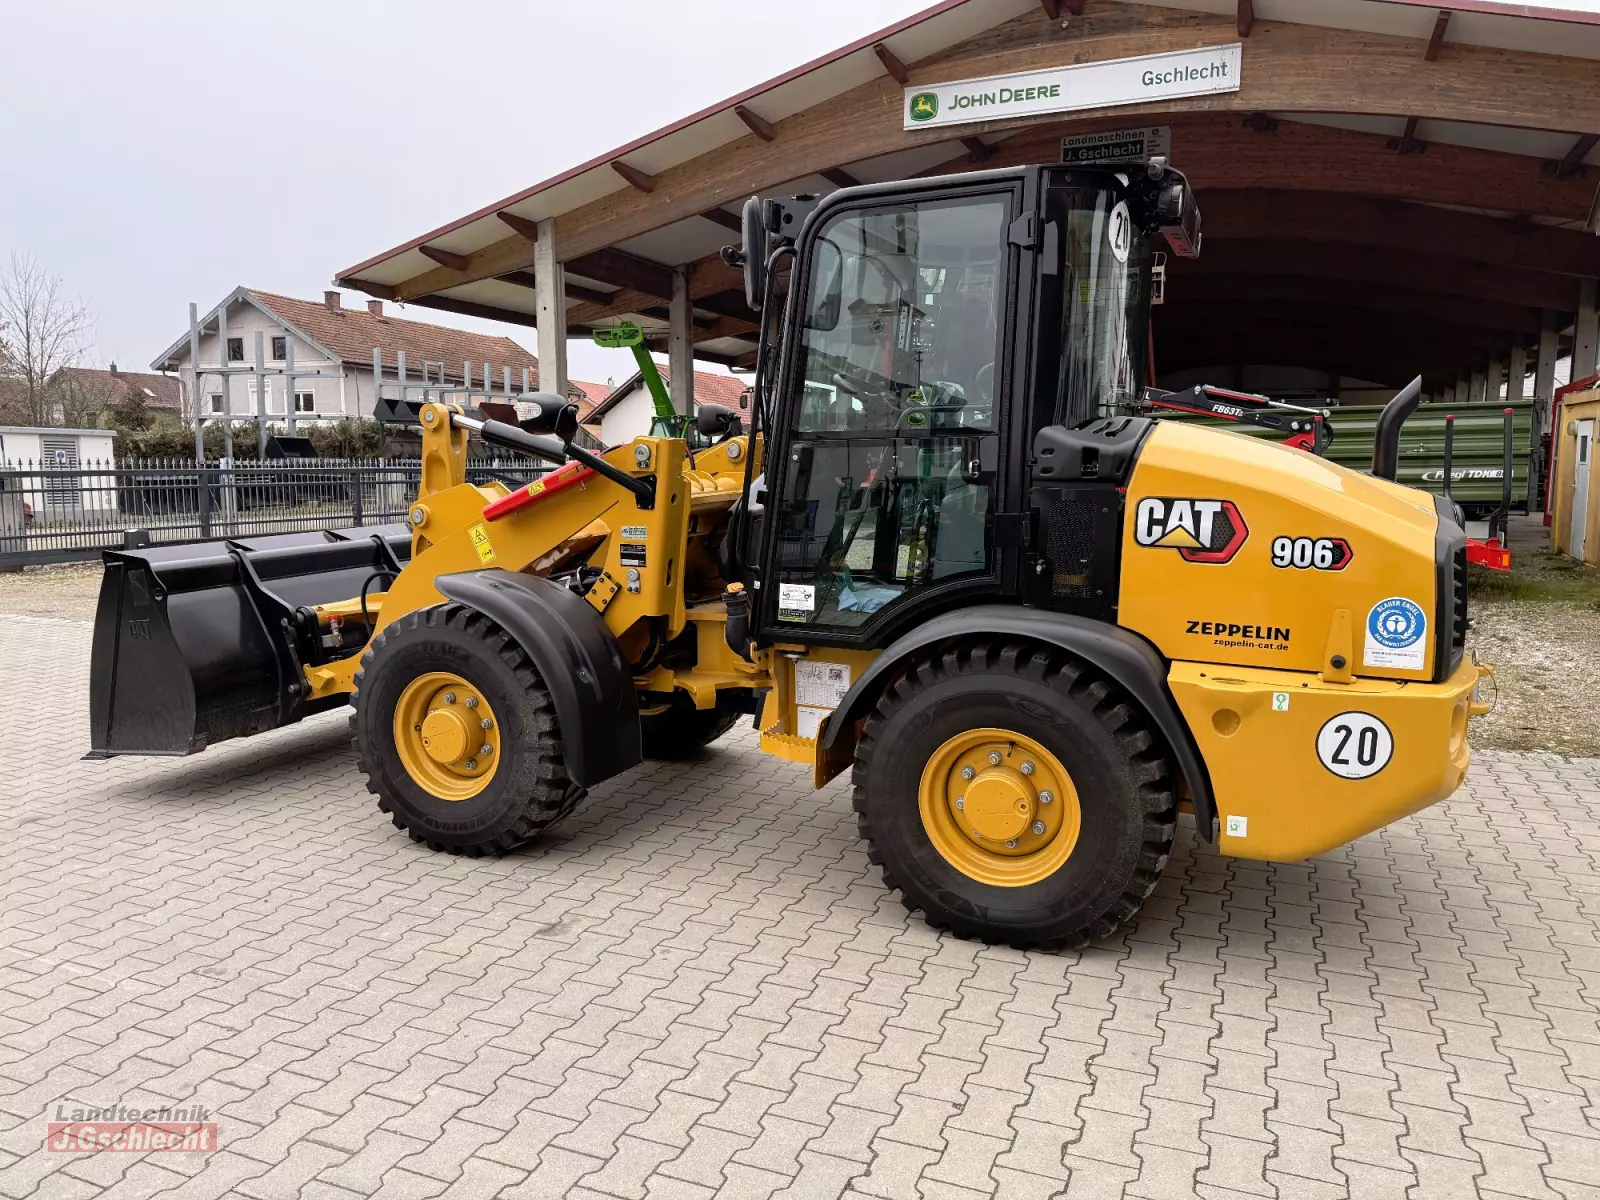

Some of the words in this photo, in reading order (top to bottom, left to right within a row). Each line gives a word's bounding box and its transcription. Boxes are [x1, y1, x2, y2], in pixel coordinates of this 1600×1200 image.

[1141, 60, 1229, 87] Gschlecht
[948, 93, 997, 111] JOHN
[999, 84, 1061, 104] DEERE
[1062, 131, 1145, 147] Landmaschinen
[1065, 150, 1076, 161] J.
[1078, 143, 1142, 160] Gschlecht
[1115, 211, 1129, 252] 20
[1136, 499, 1222, 549] CAT
[1272, 537, 1334, 568] 906
[1376, 600, 1401, 613] BLAUER
[1401, 601, 1420, 617] ENGEL
[1185, 620, 1291, 642] ZEPPELIN
[1213, 639, 1290, 651] zeppelin-cat.de
[1331, 724, 1379, 767] 20
